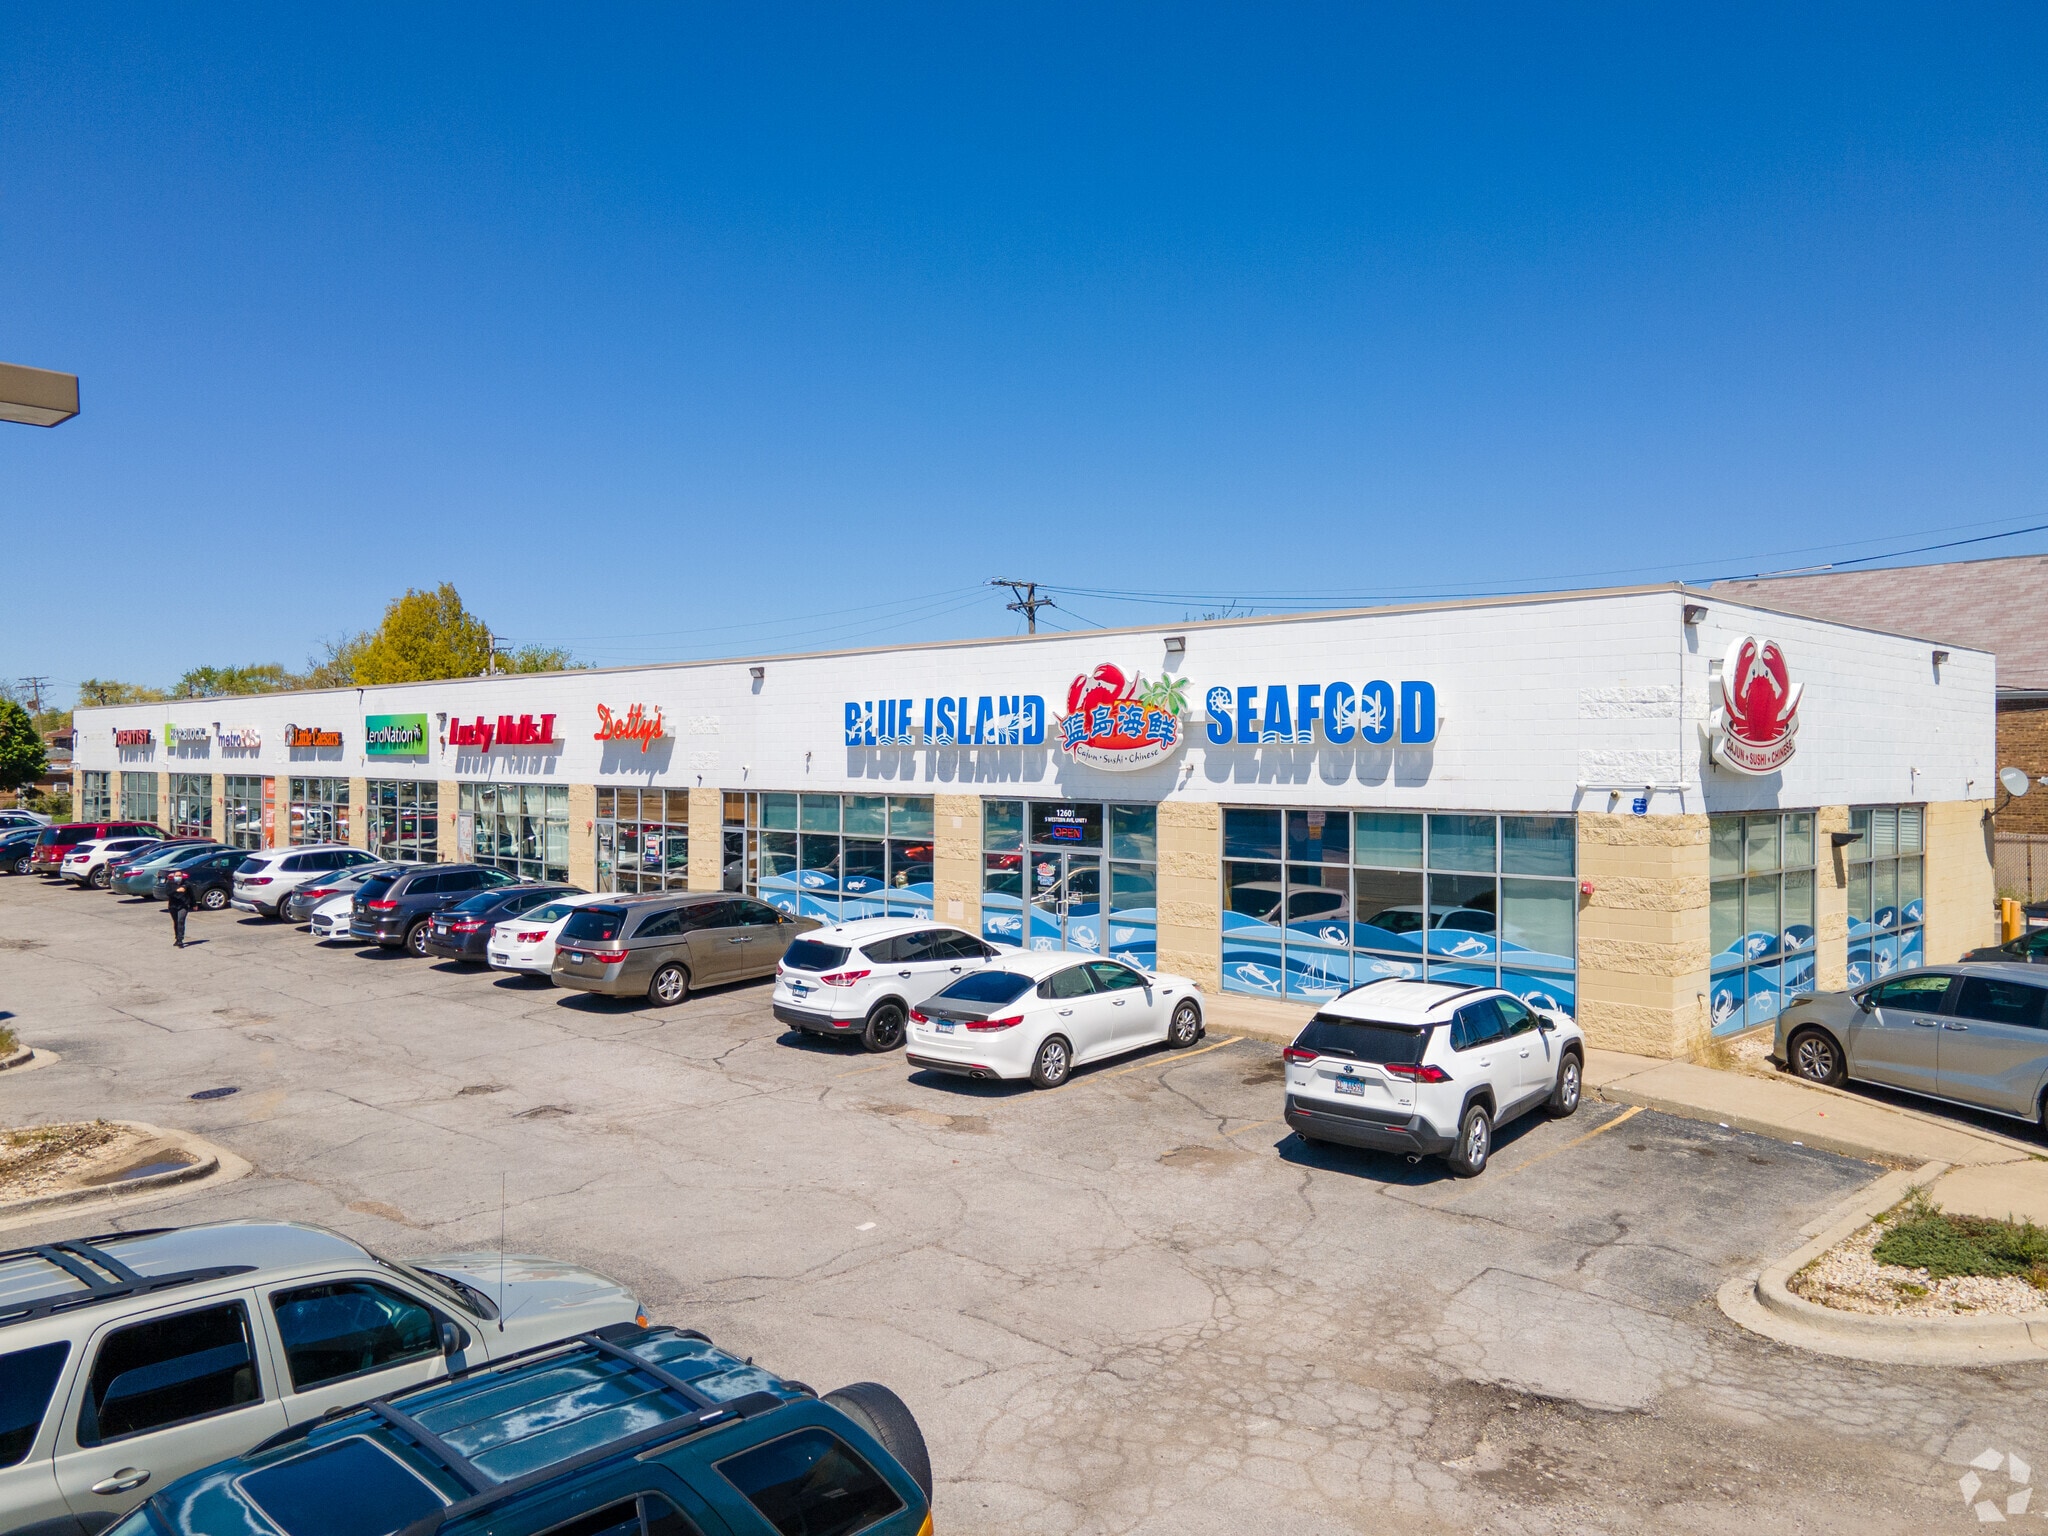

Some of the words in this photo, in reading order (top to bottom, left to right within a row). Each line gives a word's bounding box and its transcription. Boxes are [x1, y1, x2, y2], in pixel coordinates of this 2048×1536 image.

[844, 701, 913, 747] BLUE
[923, 694, 1045, 747] ISLAND
[1206, 679, 1436, 746] SEAFOOD
[117, 729, 149, 745] DENTIST
[295, 728, 312, 746] Little
[313, 727, 340, 746] Caesars
[365, 726, 413, 744] LendNation
[448, 715, 496, 753] Lucky
[495, 714, 541, 745] Nails
[594, 703, 664, 754] Dotty's
[1076, 746, 1098, 761] Cajun
[1103, 754, 1123, 765] Sushi
[1128, 748, 1160, 763] Chinese
[1726, 738, 1745, 762] CAJUN
[1749, 752, 1767, 766] SUSHI
[1771, 738, 1793, 763] CHINESE
[1056, 809, 1075, 817] 12601
[1054, 827, 1080, 838] OPEN
